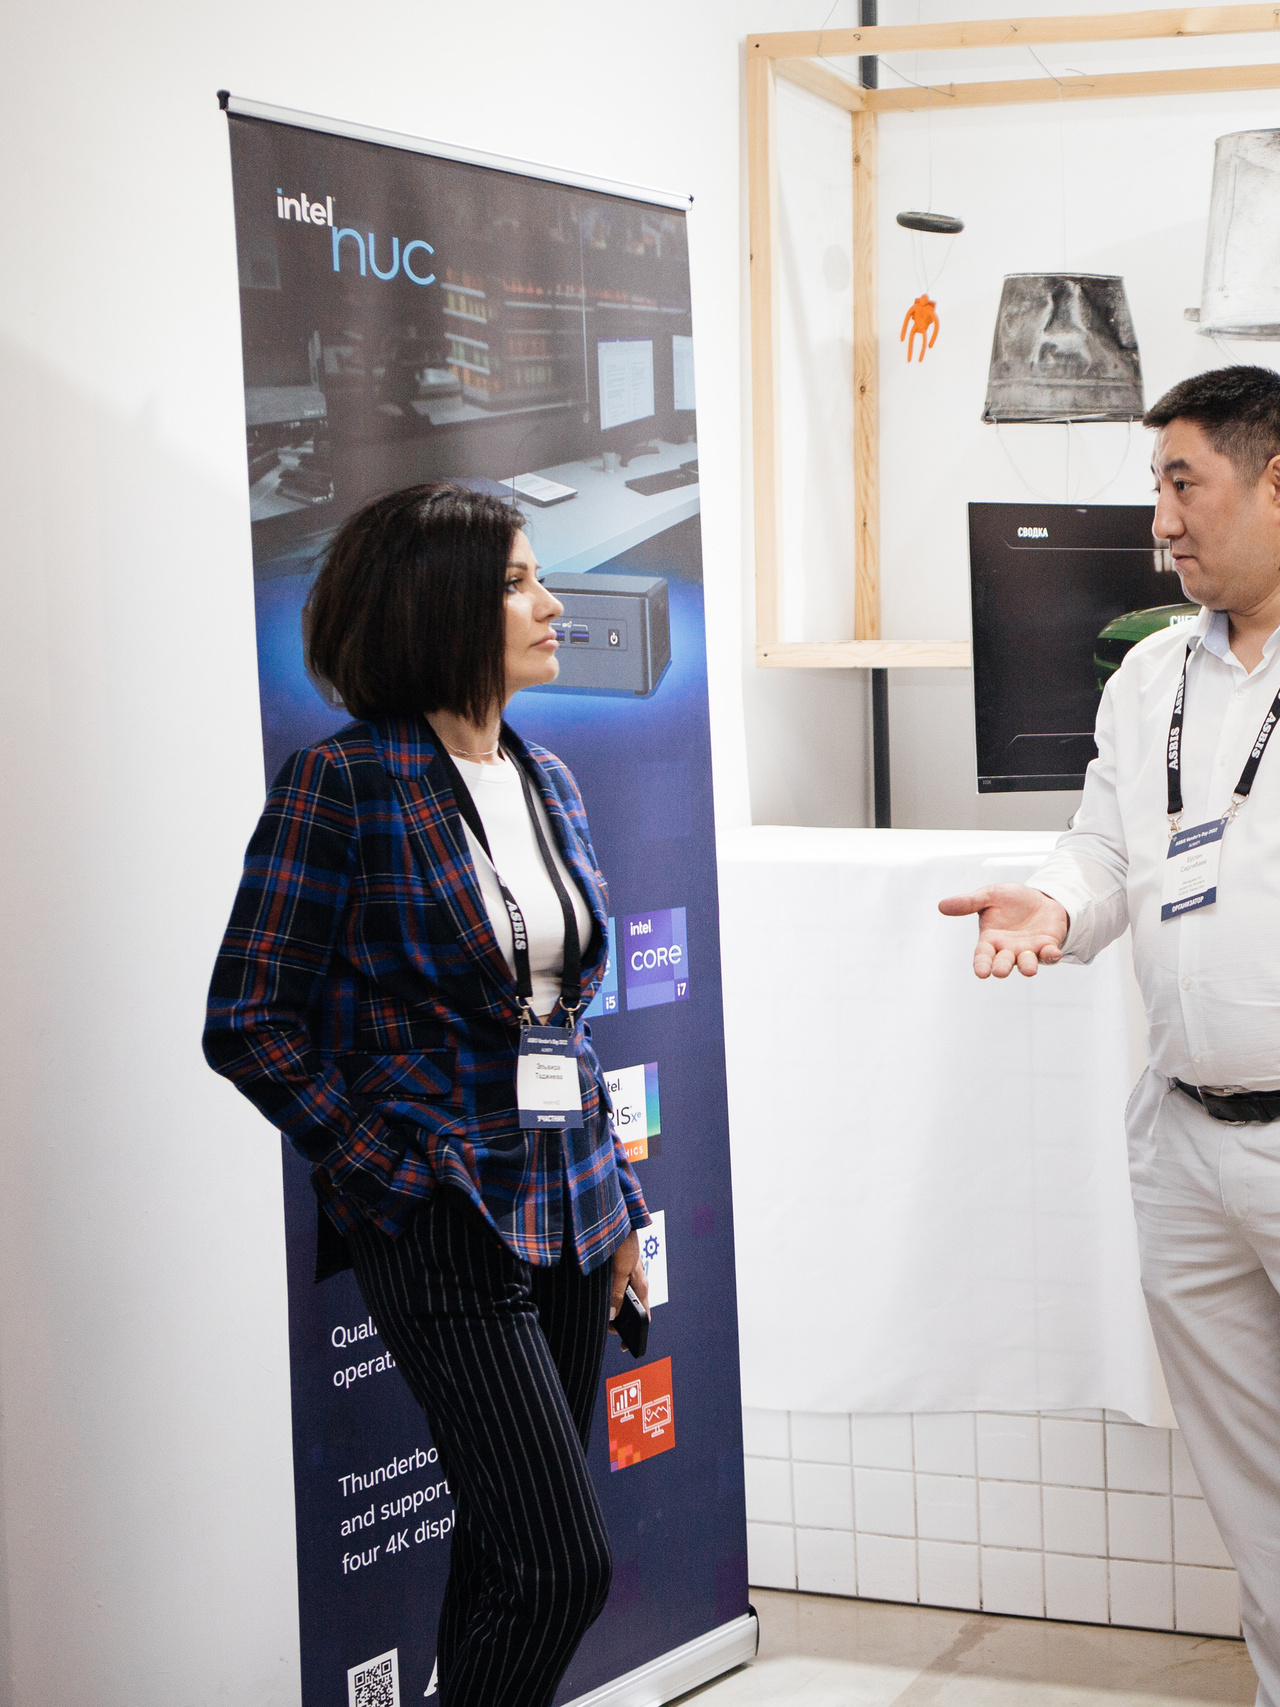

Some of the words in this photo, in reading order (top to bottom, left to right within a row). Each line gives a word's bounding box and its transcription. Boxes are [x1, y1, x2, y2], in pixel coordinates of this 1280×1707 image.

[276, 187, 333, 227] intel
[331, 226, 436, 286] nuc
[1017, 527, 1049, 539] СВОДКА
[1168, 726, 1180, 770] ASBIS
[1251, 711, 1277, 759] ASBIS
[506, 900, 527, 951] ASBIS
[630, 919, 652, 936] intel
[605, 996, 616, 1010] i5
[677, 982, 687, 996] i7
[607, 1079, 621, 1093] tel
[624, 1145, 644, 1158] HICS
[338, 1447, 438, 1497] Thunderbo
[341, 1503, 375, 1536] and
[342, 1545, 381, 1575] four
[385, 1528, 410, 1554] 4K
[414, 1509, 455, 1543] displ
